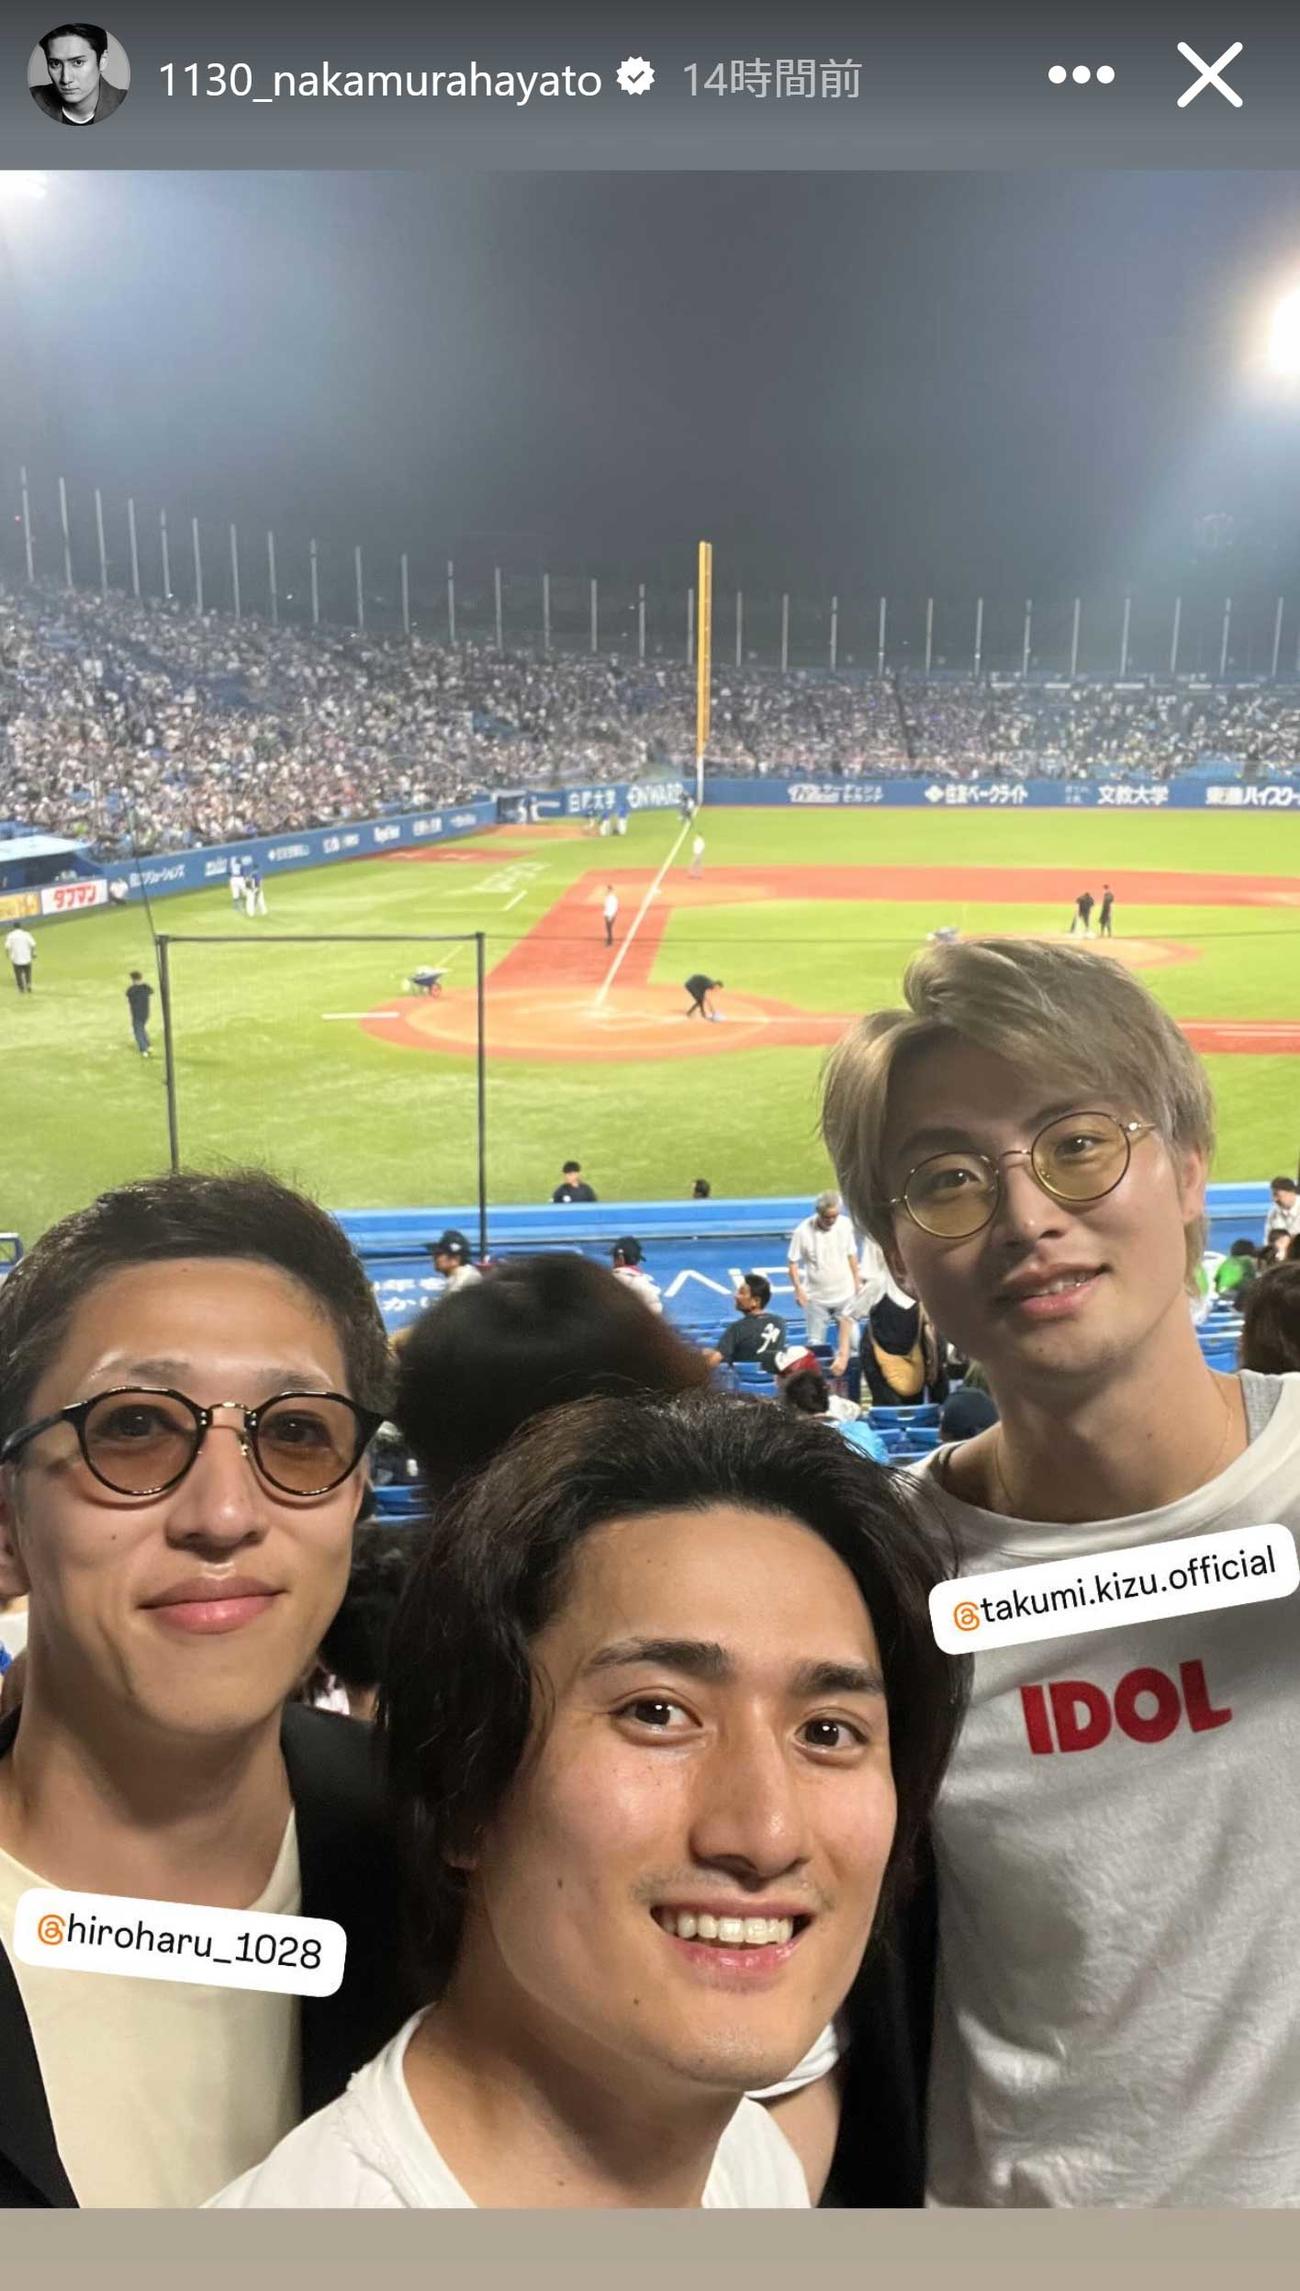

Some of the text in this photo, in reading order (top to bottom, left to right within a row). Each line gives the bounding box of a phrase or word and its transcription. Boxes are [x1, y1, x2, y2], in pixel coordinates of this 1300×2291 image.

[1097, 784, 1169, 806] 文教大学
[1206, 786, 1300, 806] 東進ハイスクー
[54, 884, 97, 909] タフマン
[1020, 1659, 1233, 1755] IDOL
